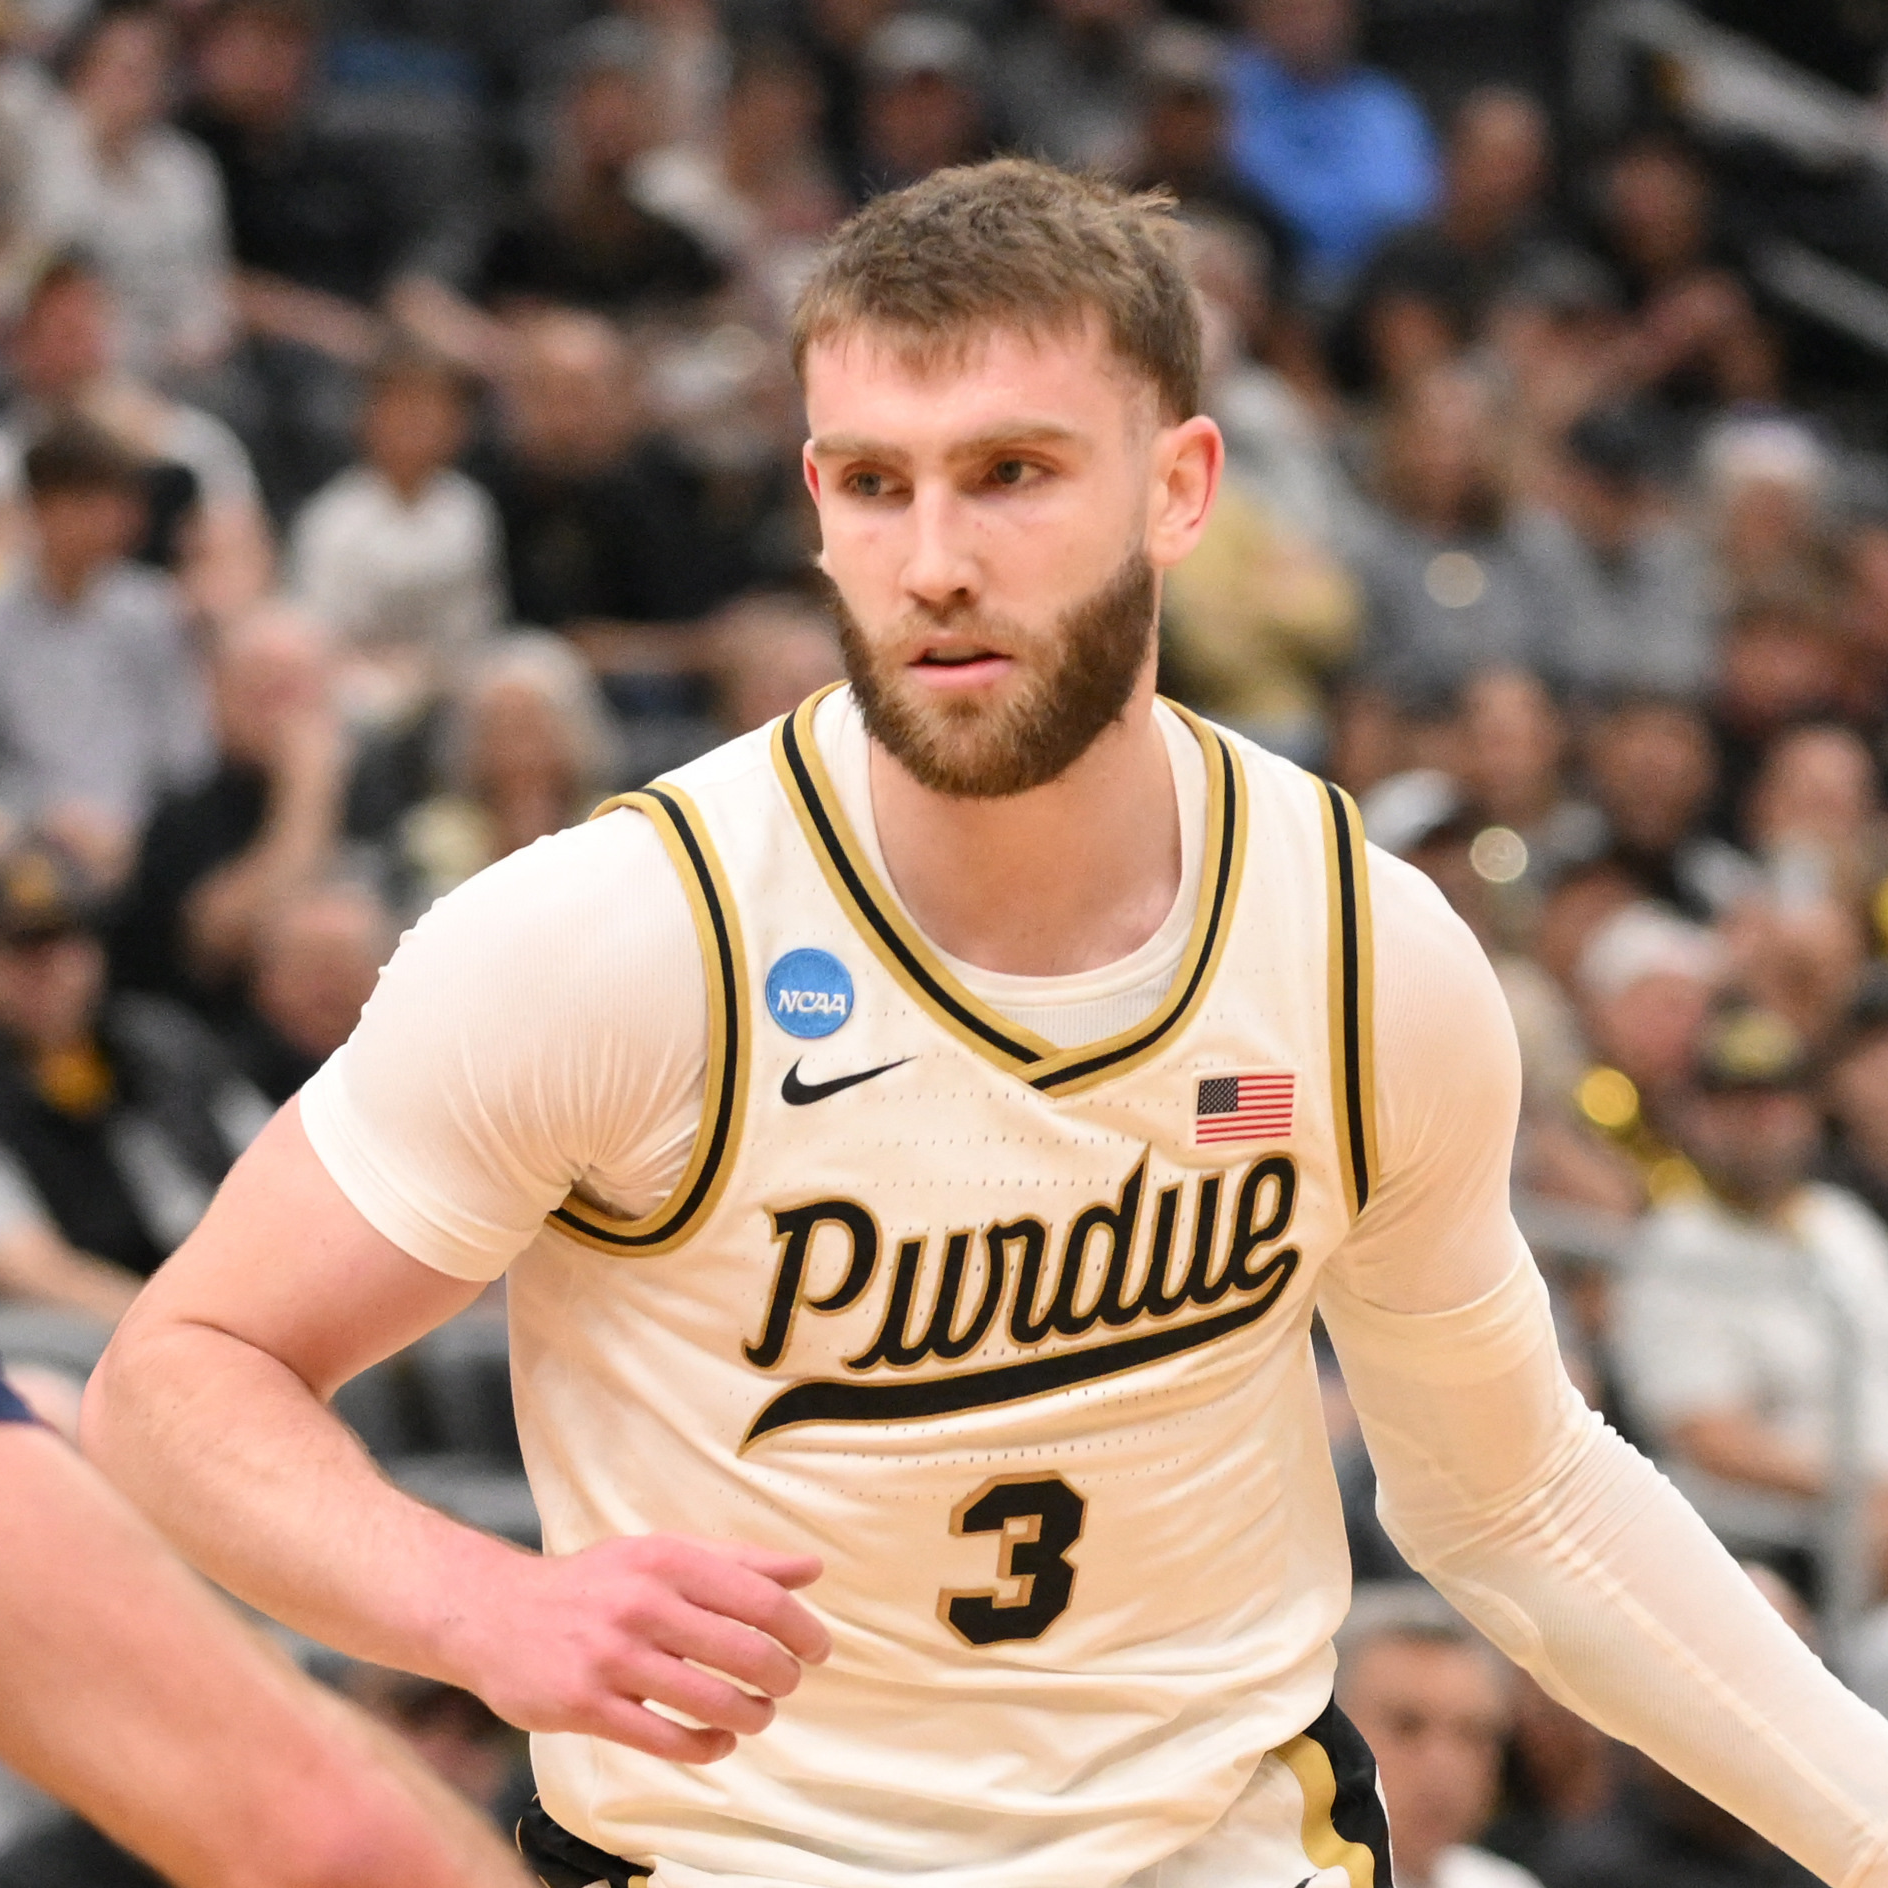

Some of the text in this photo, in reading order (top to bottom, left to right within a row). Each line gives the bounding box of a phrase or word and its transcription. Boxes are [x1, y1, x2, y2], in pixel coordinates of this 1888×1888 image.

[777, 989, 847, 1016] NCAA
[741, 1142, 1308, 1376] Purdue
[935, 1469, 1089, 1648] 3
